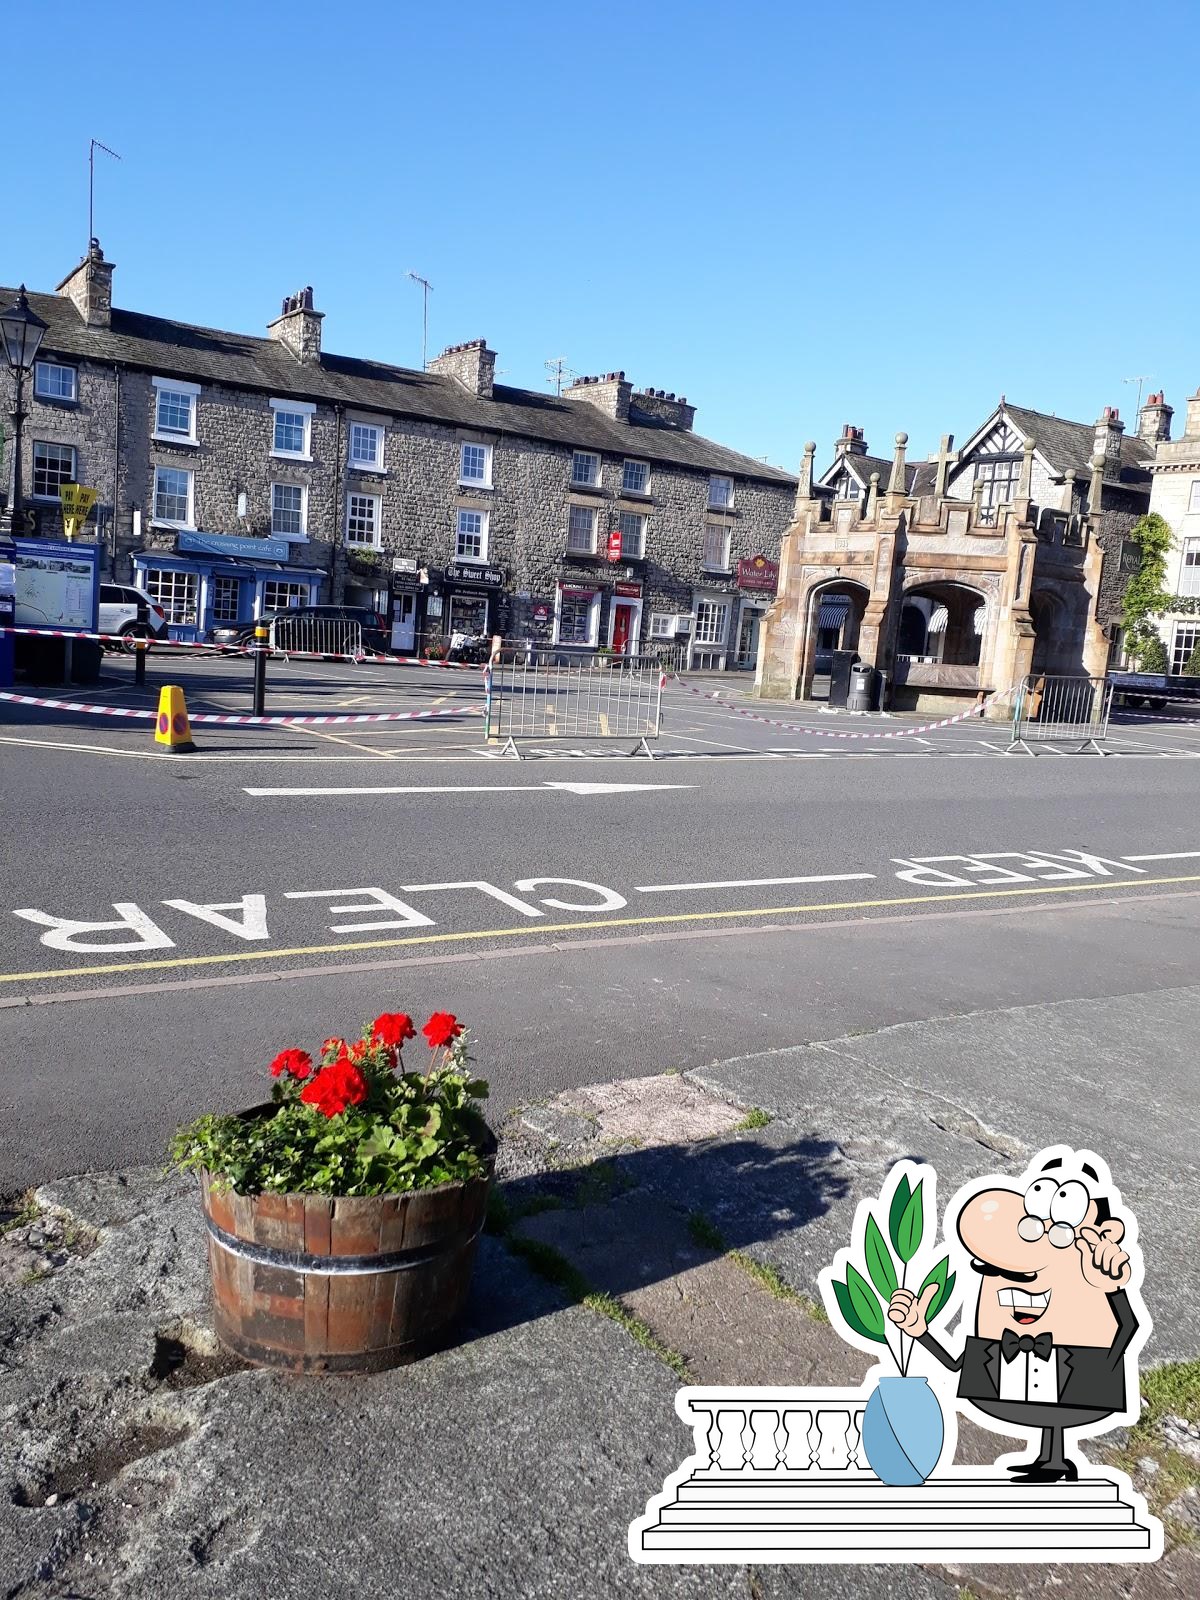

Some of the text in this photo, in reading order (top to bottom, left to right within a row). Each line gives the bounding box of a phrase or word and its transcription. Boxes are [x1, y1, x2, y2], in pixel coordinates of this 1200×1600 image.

[65, 490, 73, 501] PAY
[80, 492, 90, 503] PAY
[64, 504, 74, 514] HERE
[76, 504, 88, 516] HERE
[239, 543, 258, 551] point
[447, 566, 460, 577] The
[463, 568, 482, 579] Sweet
[485, 570, 501, 583] Shop
[742, 567, 777, 580] Water Lily
[12, 848, 1149, 953] KEEP CLEAR
